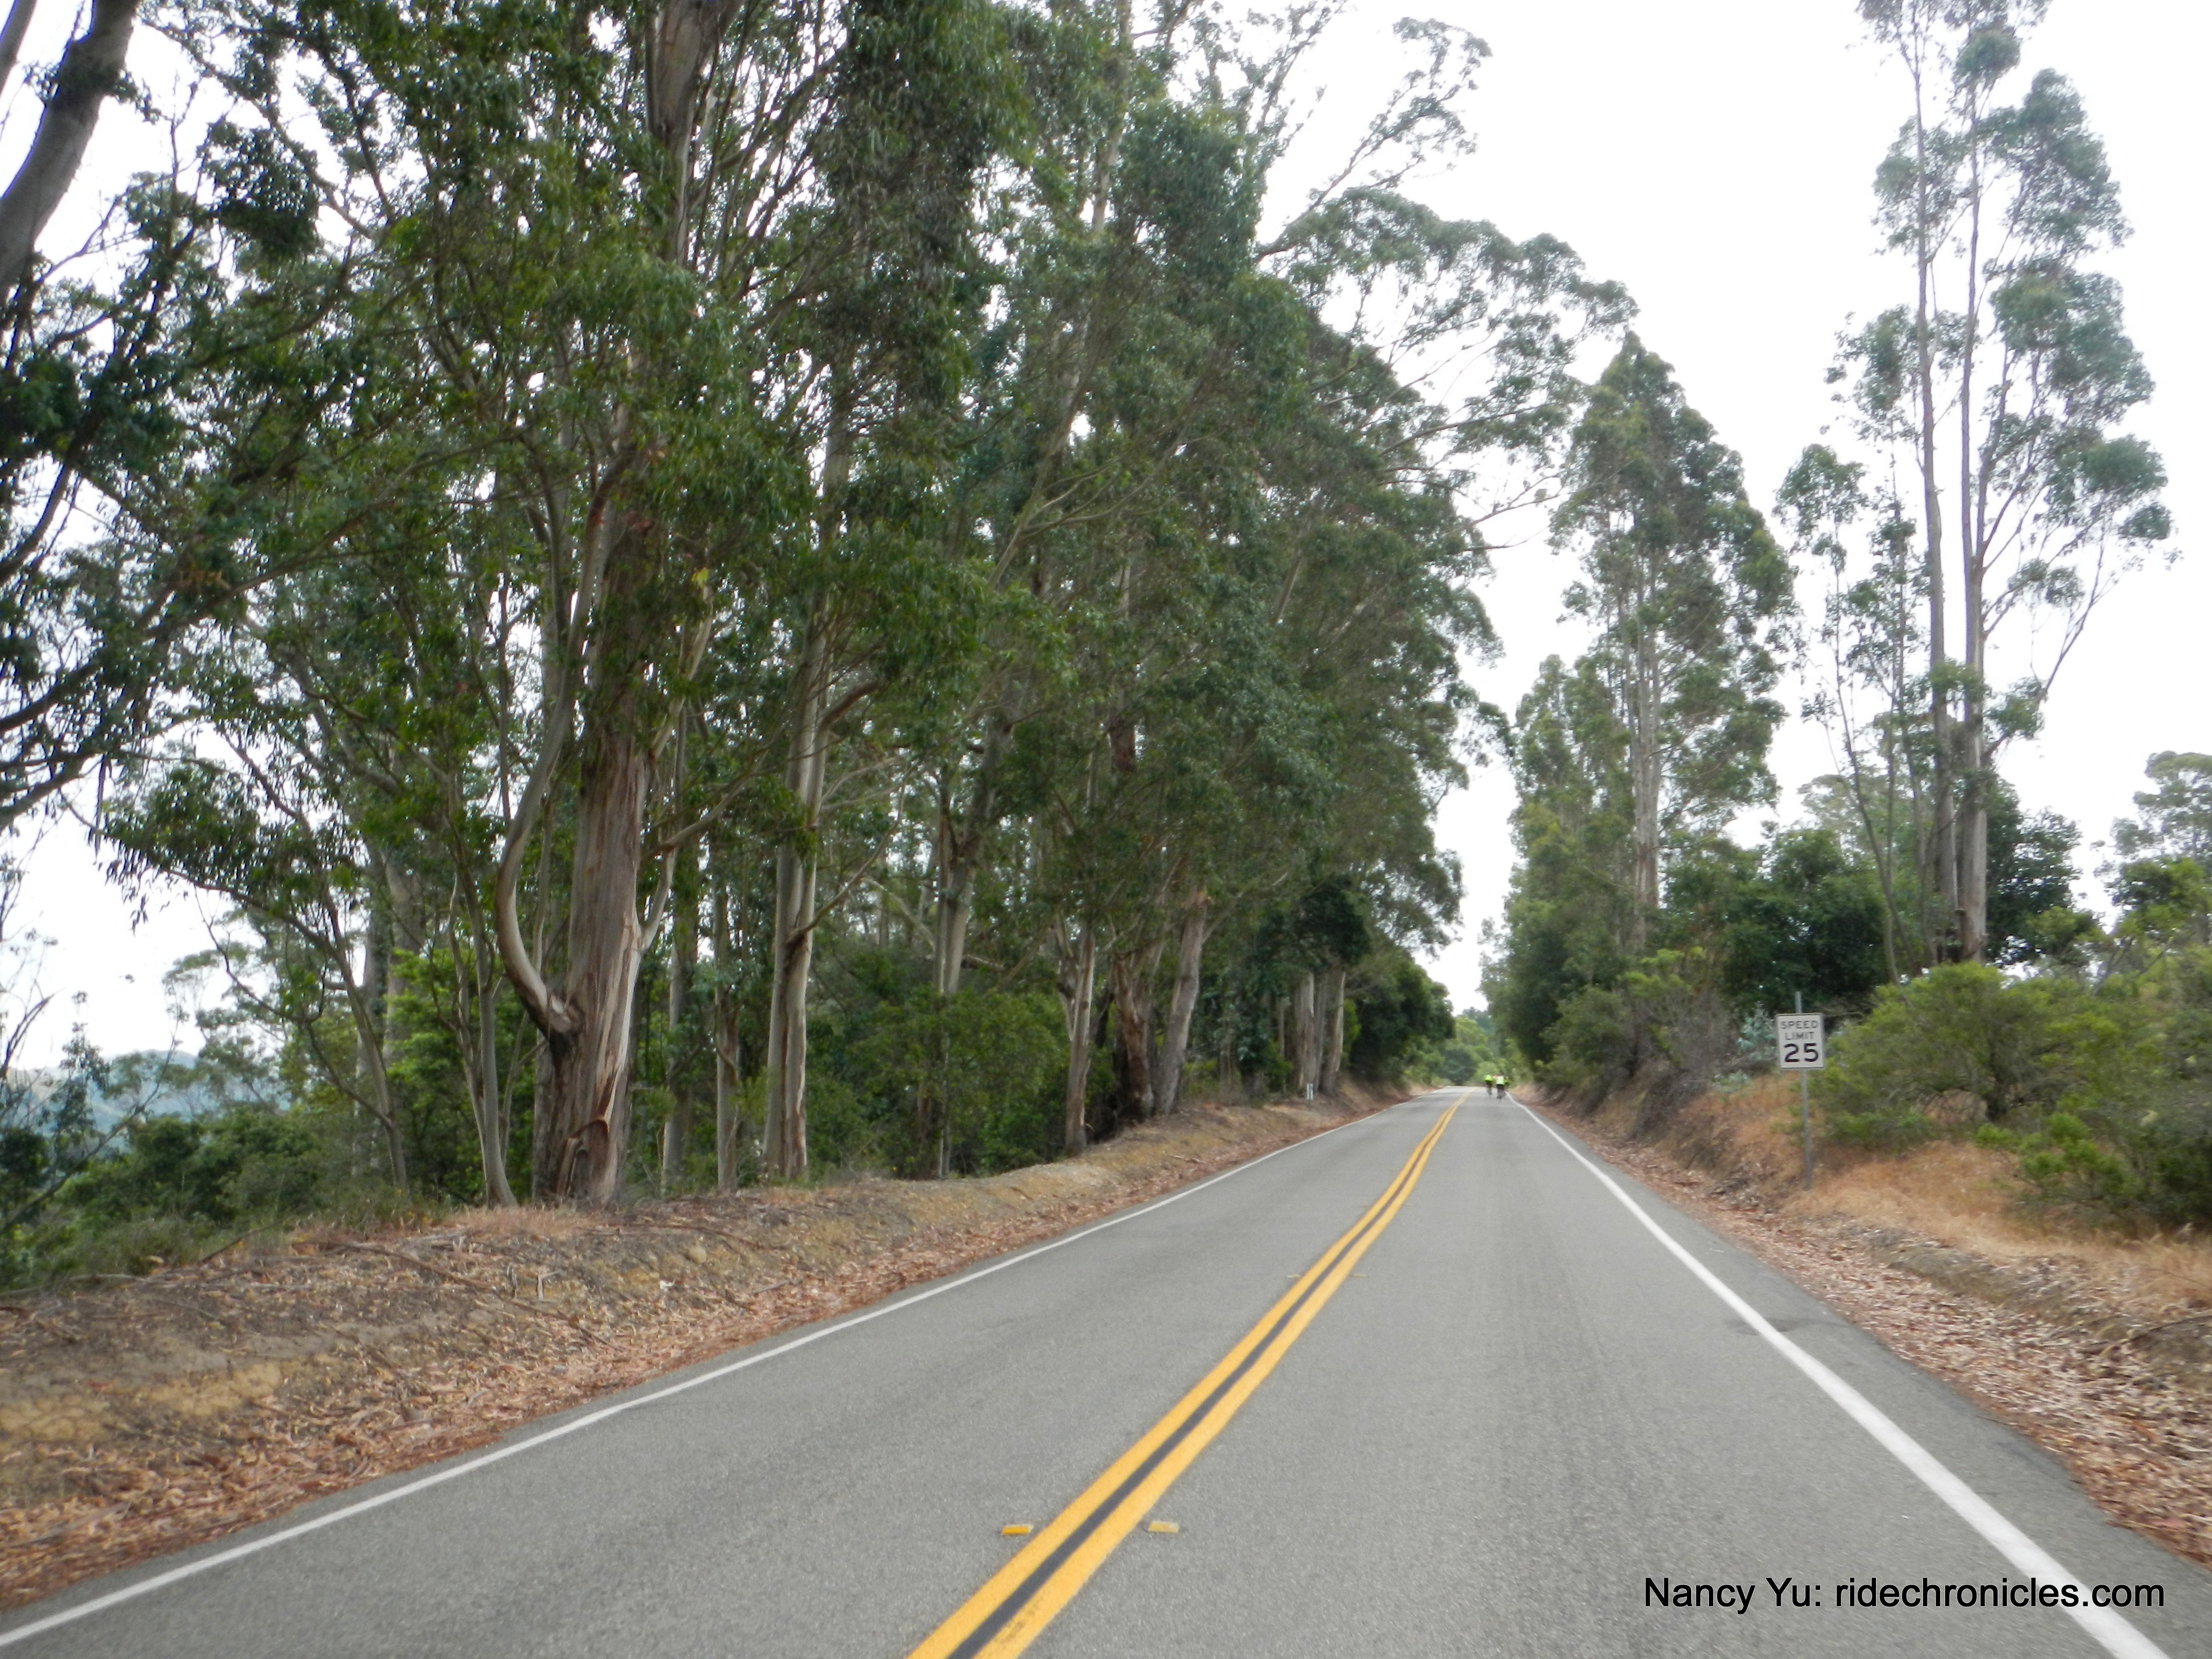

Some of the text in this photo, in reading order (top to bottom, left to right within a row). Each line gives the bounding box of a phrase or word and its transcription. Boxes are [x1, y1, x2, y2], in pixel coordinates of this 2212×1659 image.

[1781, 1021, 1817, 1029] SPEED
[1785, 1032, 1814, 1040] LIMIT
[1784, 1043, 1818, 1062] 25
